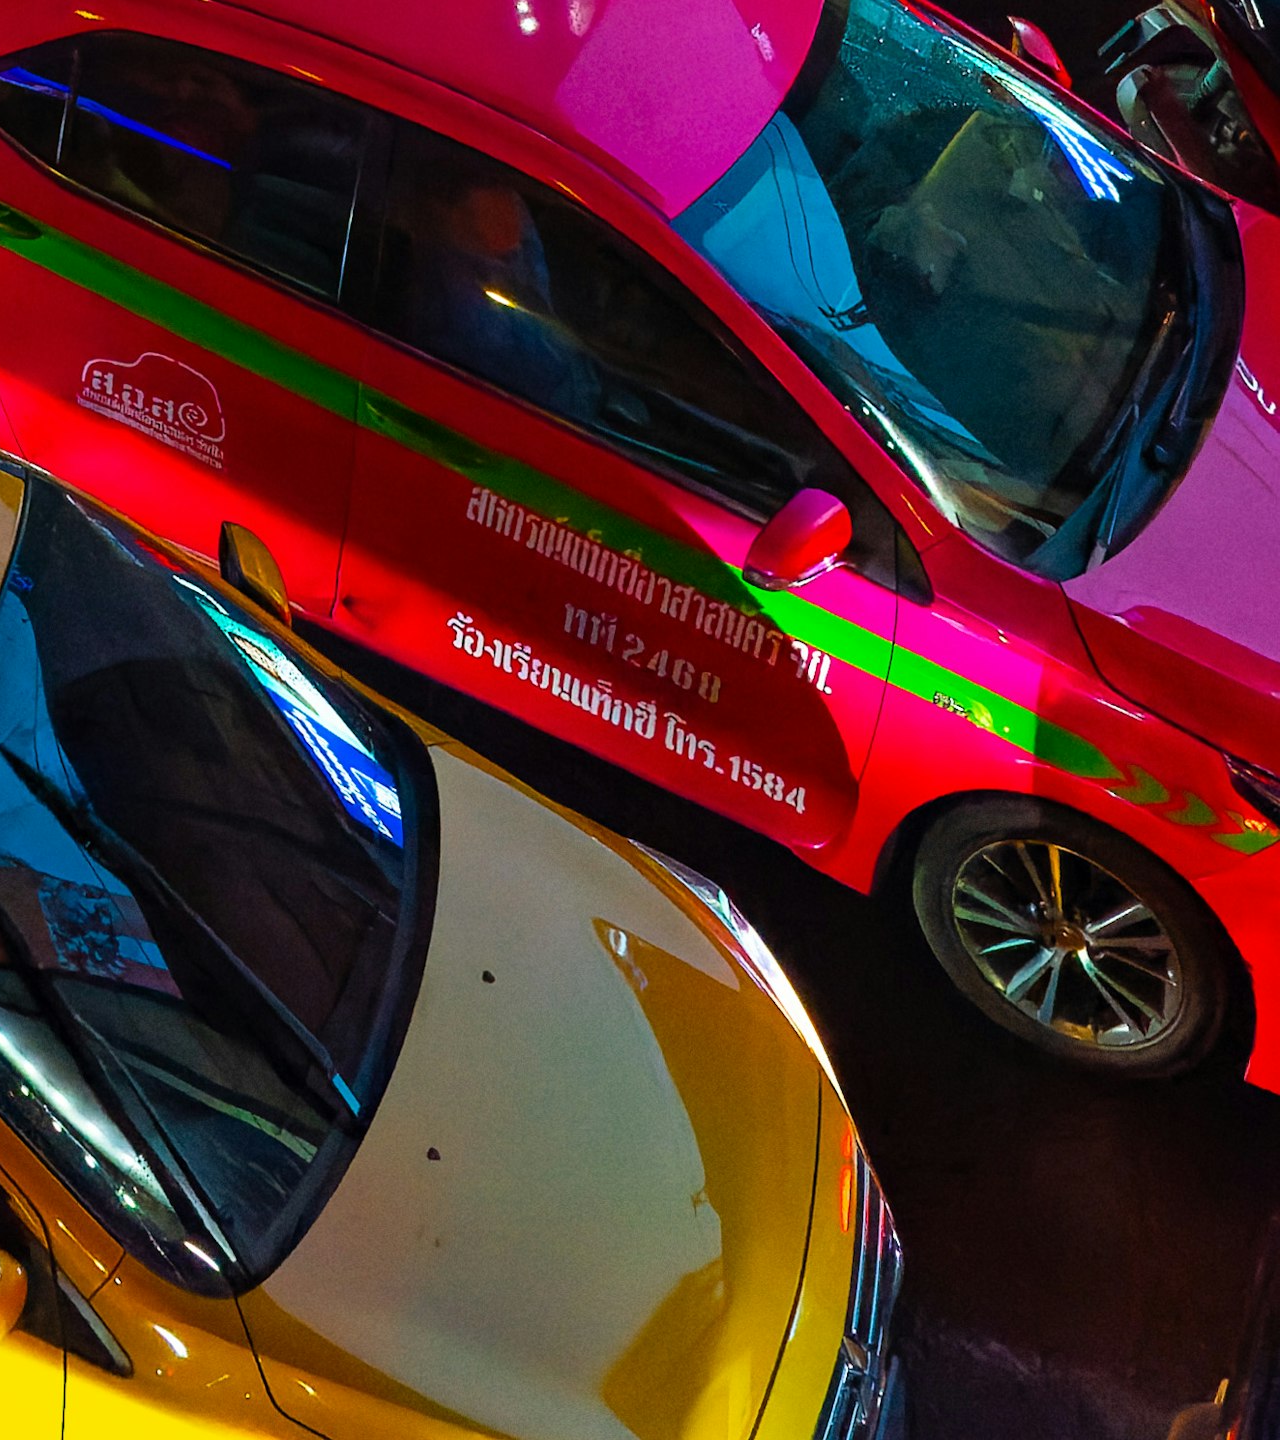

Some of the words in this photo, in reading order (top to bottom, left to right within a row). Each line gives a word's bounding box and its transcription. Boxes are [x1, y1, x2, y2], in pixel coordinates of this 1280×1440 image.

[446, 610, 658, 740] ร้องเรียนแท็กซี่
[623, 632, 722, 704] 2468
